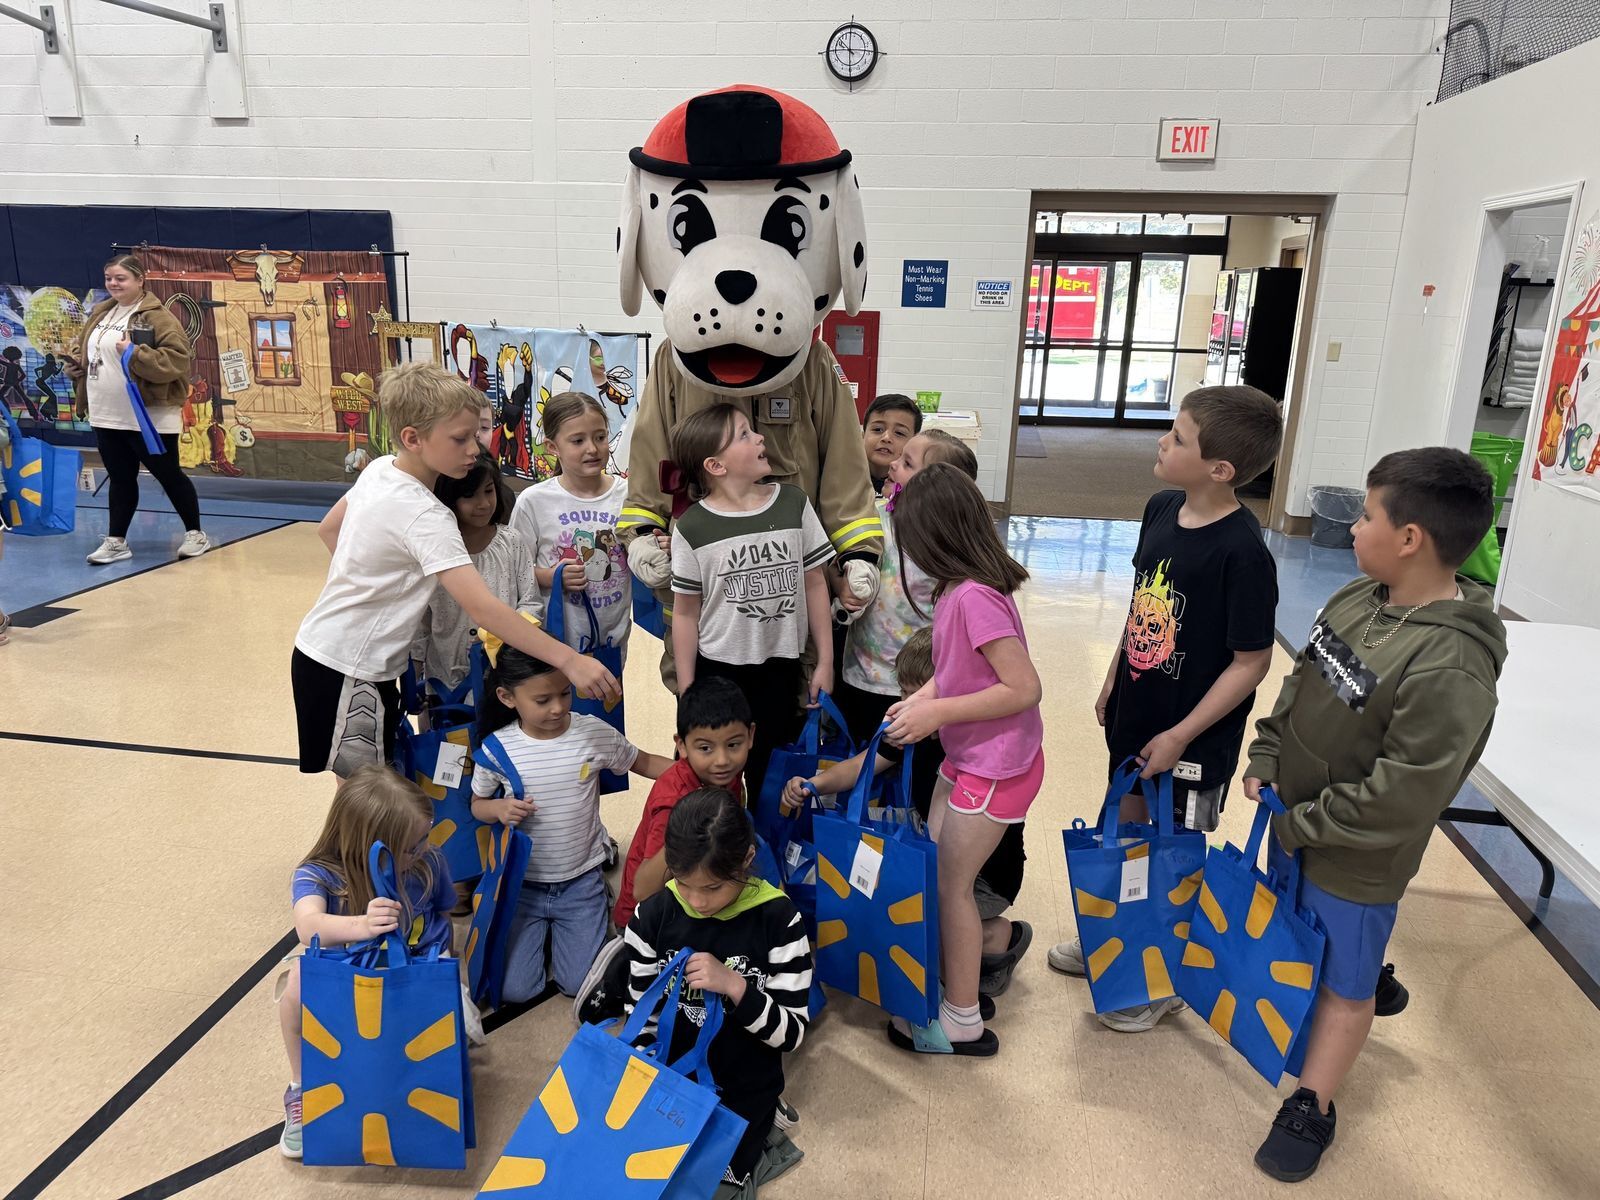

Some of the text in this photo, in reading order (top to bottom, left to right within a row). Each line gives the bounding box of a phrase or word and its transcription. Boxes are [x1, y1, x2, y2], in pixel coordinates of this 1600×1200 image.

[1171, 126, 1210, 153] EXIT
[907, 265, 943, 274] Must Wear
[905, 275, 945, 285] Non-Marking
[978, 282, 1009, 290] NOTICE
[915, 284, 934, 293] Tennis
[914, 293, 933, 302] Shoes
[383, 323, 437, 335] WANTED
[337, 400, 363, 411] WEST
[558, 510, 620, 527] SQUISH
[748, 542, 773, 565] 04
[723, 565, 799, 600] JUSTIC
[570, 590, 622, 608] SUAD
[1309, 624, 1365, 696] Champion
